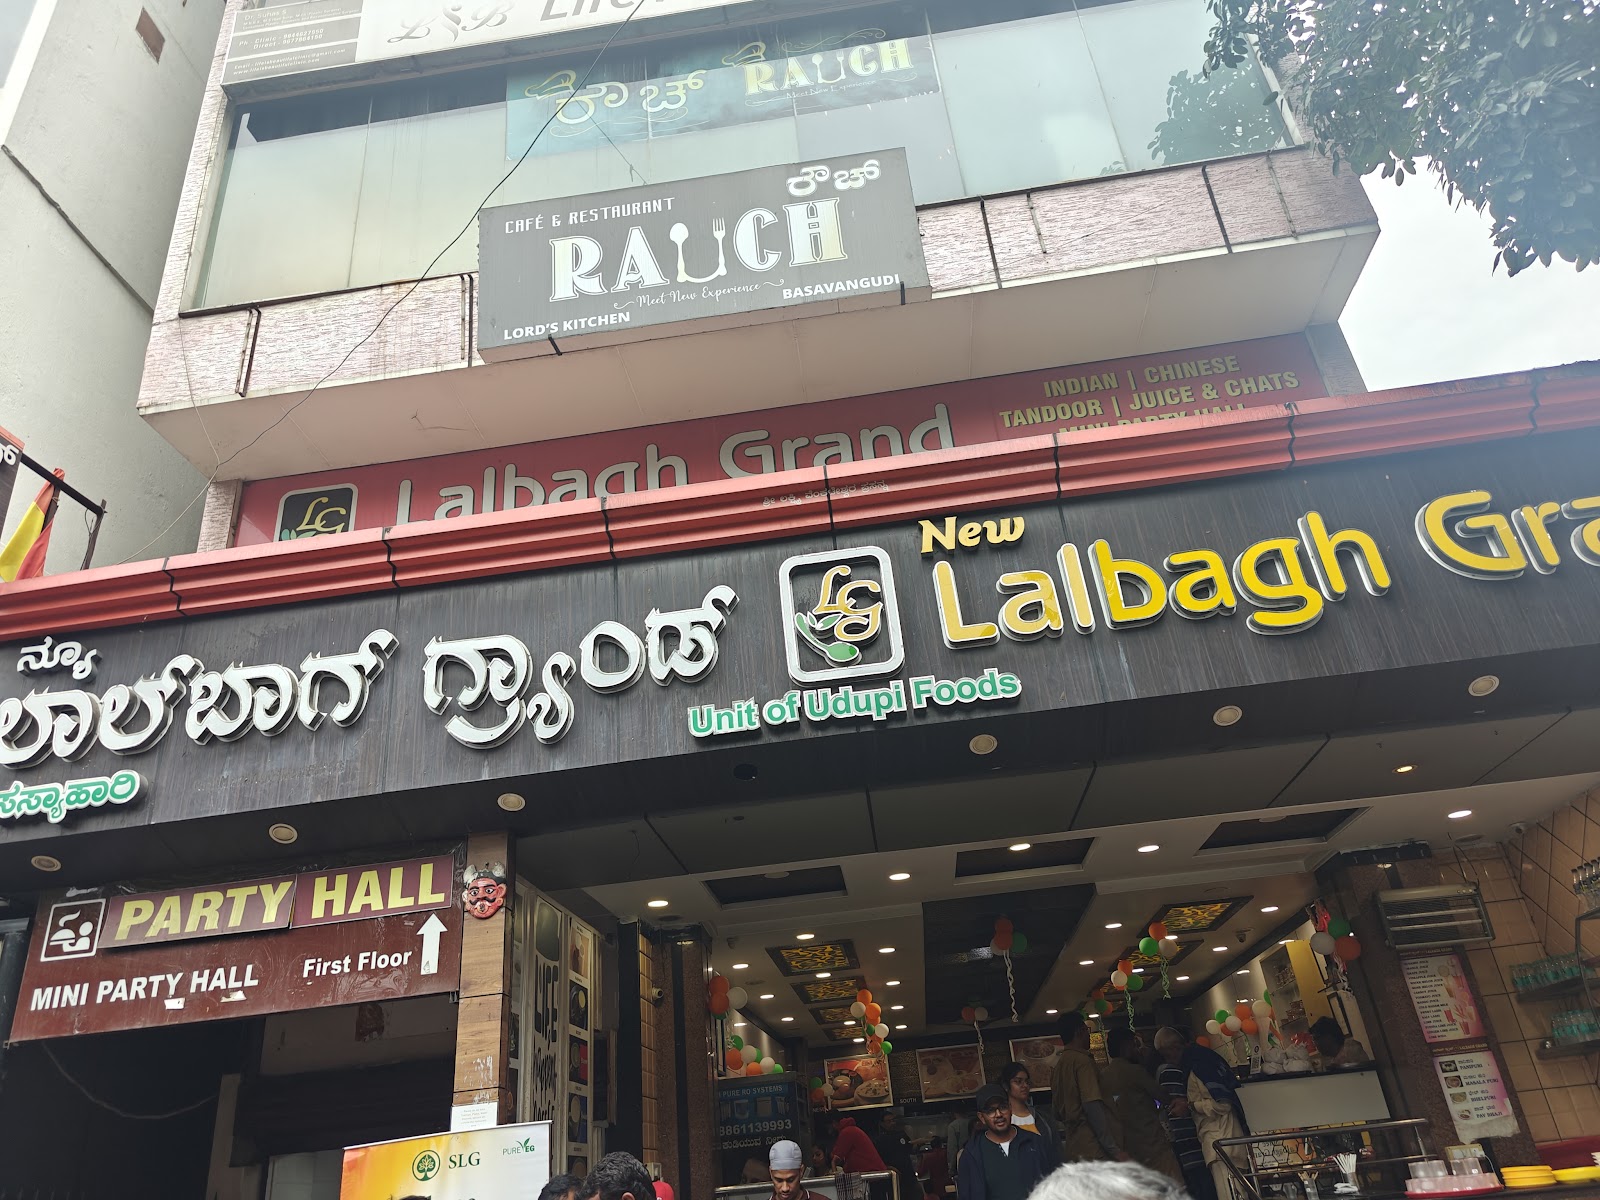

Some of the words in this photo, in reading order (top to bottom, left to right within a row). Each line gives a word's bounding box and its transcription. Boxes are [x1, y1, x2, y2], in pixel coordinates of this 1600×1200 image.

[743, 38, 913, 96] RAUCH
[505, 214, 544, 235] CAFÉ
[551, 211, 562, 228] &
[568, 196, 676, 226] RESTAURANT
[548, 196, 849, 303] RAUCH
[636, 293, 666, 308] Meet
[667, 290, 697, 302] New
[701, 282, 761, 302] Experience
[782, 273, 900, 300] BASAVANGUDI
[503, 321, 560, 341] LORD'S
[562, 311, 631, 333] KITCHEN
[1044, 372, 1119, 398] INDIAN
[1144, 355, 1240, 384] CHINESE
[1000, 399, 1104, 428] TANDOOR
[1129, 382, 1195, 411] JUICE
[1202, 382, 1220, 400] &
[1224, 371, 1299, 398] CHATS
[719, 402, 955, 478] Grand
[919, 516, 1025, 554] New
[933, 510, 1392, 649] Lalbagh
[688, 697, 759, 737] Unit
[762, 686, 801, 726] of
[802, 681, 904, 721] Udupi
[909, 668, 1022, 709] Foods
[114, 879, 295, 942] PARTY
[311, 862, 446, 920] HALL
[301, 953, 352, 979] First
[356, 948, 413, 971] Floor
[30, 982, 88, 1012] MINI
[95, 972, 184, 1005] PARTY
[189, 964, 260, 993] HALL
[722, 1089, 740, 1097] PURE
[752, 1084, 783, 1094] SYSTEMS
[448, 1151, 481, 1170] SLG
